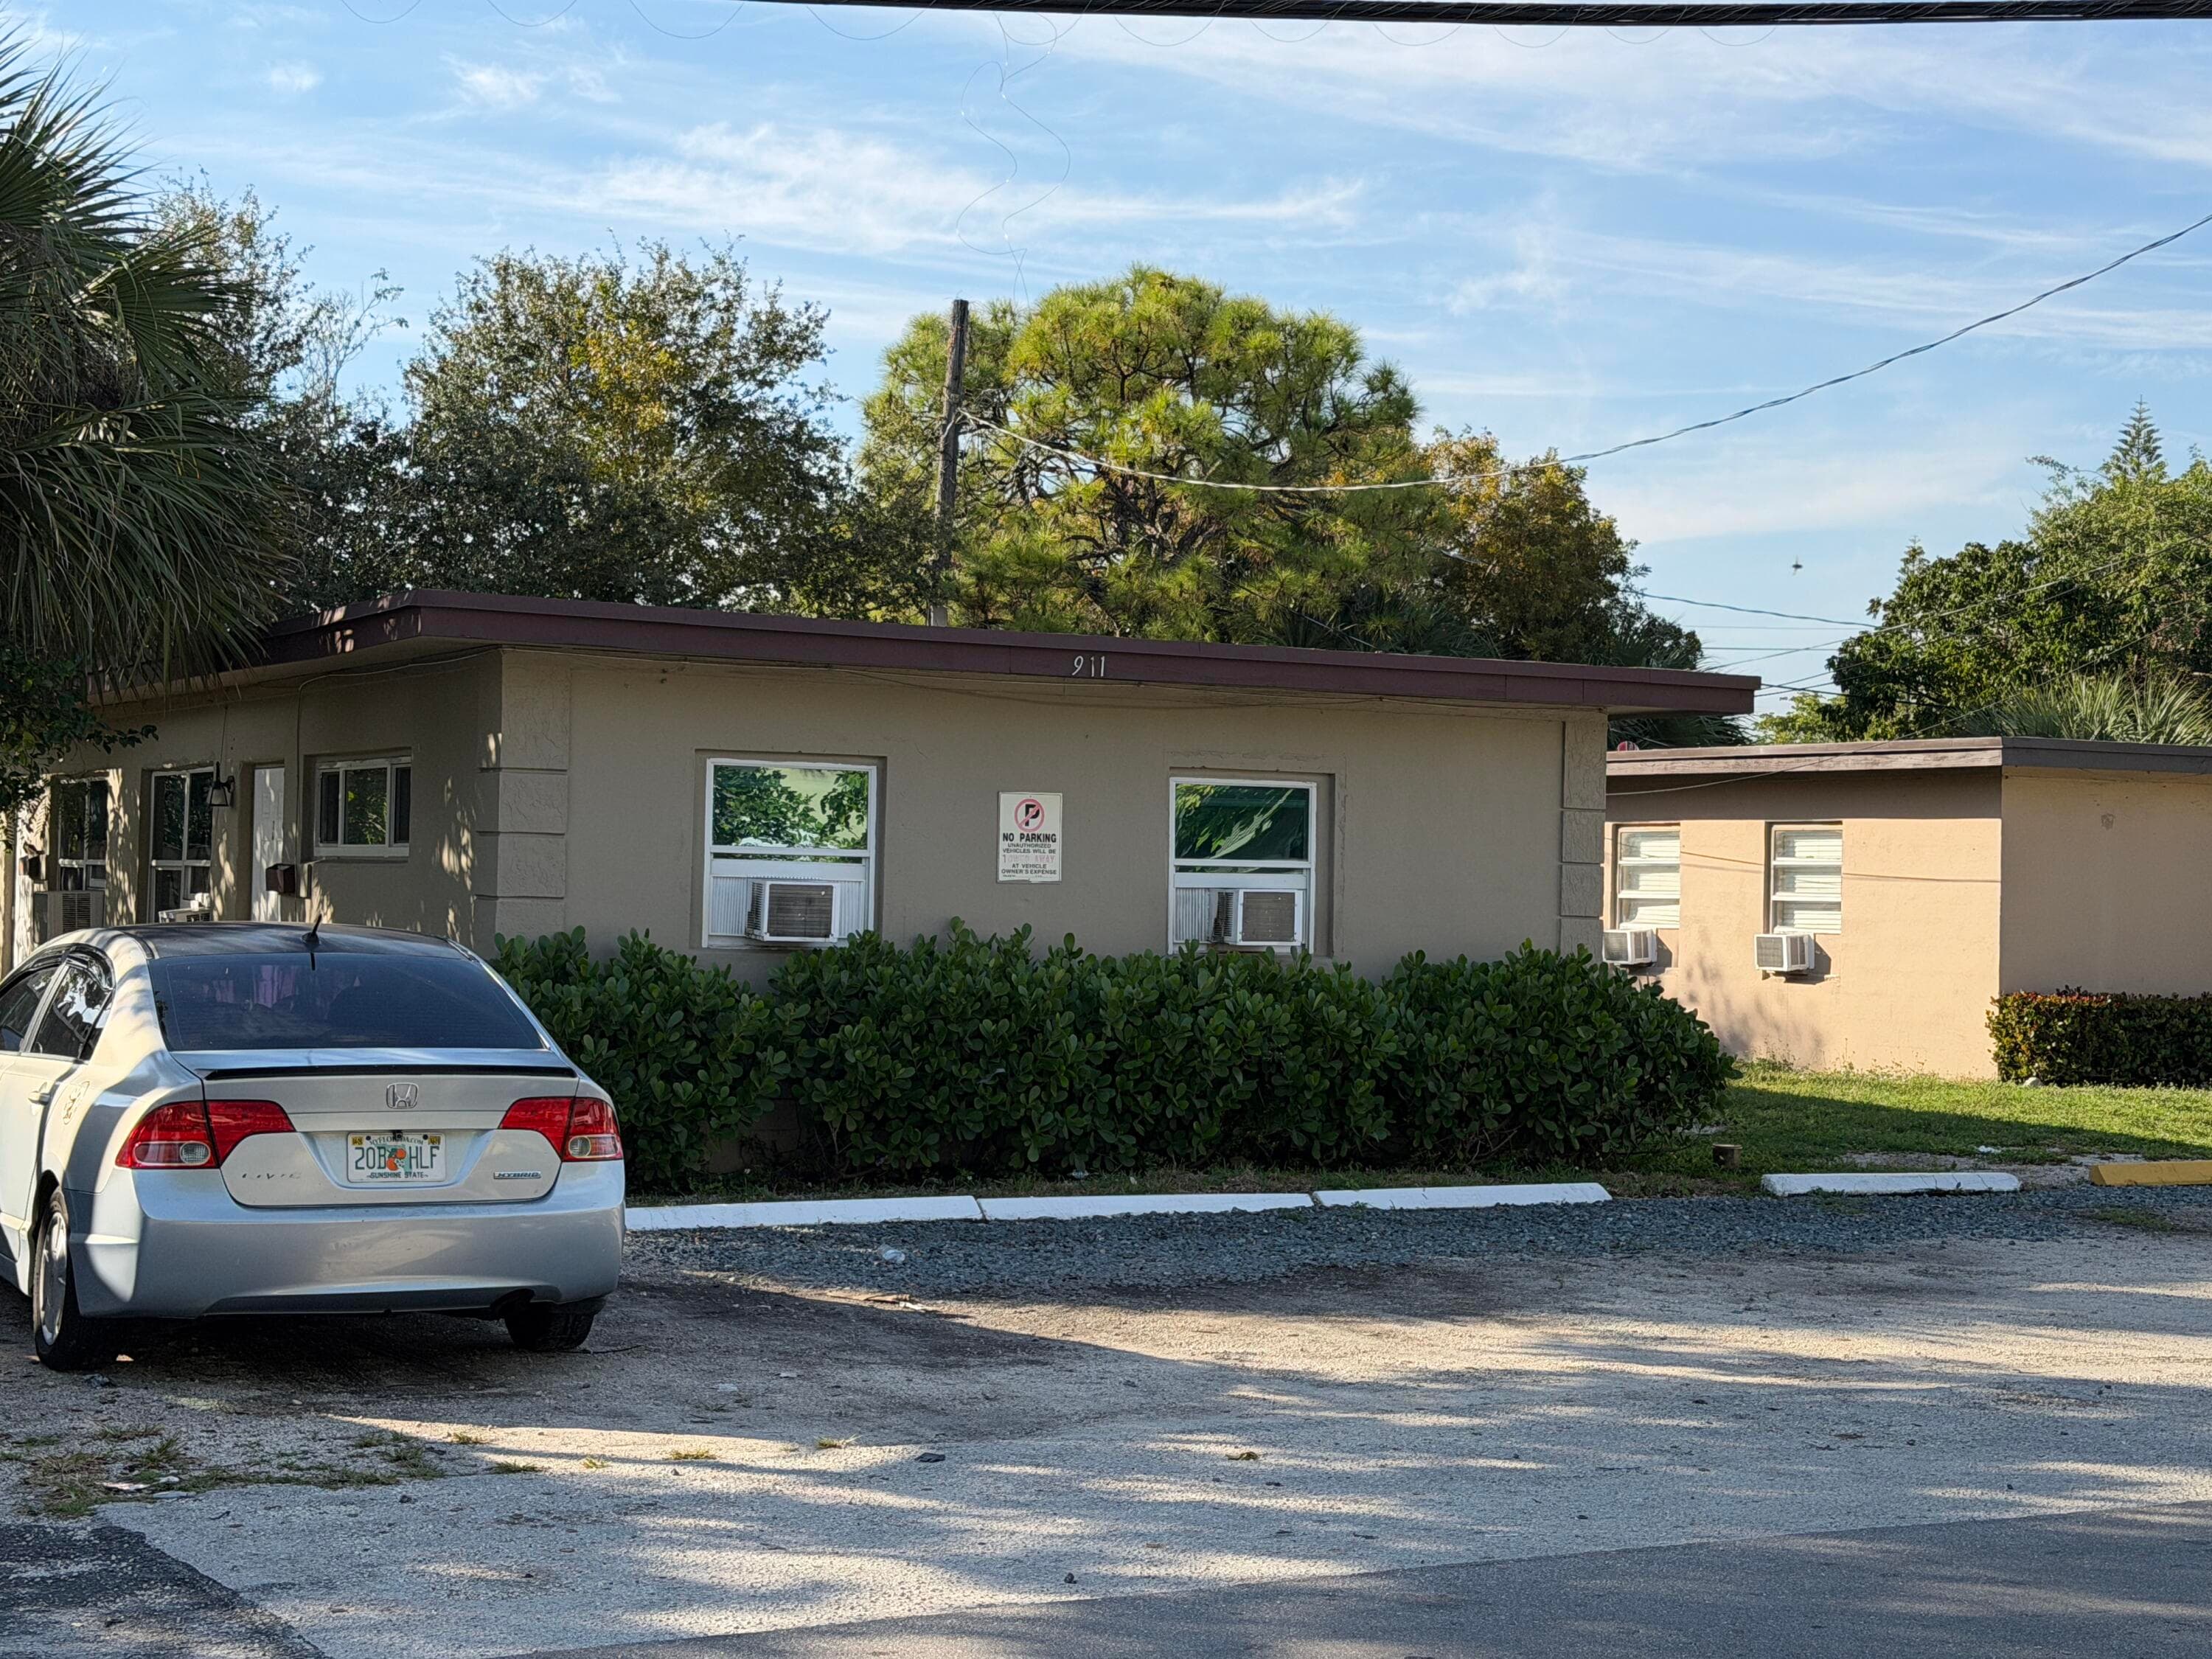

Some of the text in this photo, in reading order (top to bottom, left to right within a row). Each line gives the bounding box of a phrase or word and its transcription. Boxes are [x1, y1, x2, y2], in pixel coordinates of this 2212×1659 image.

[1071, 655, 1105, 677] 911
[1003, 832, 1057, 843] NO PARKING
